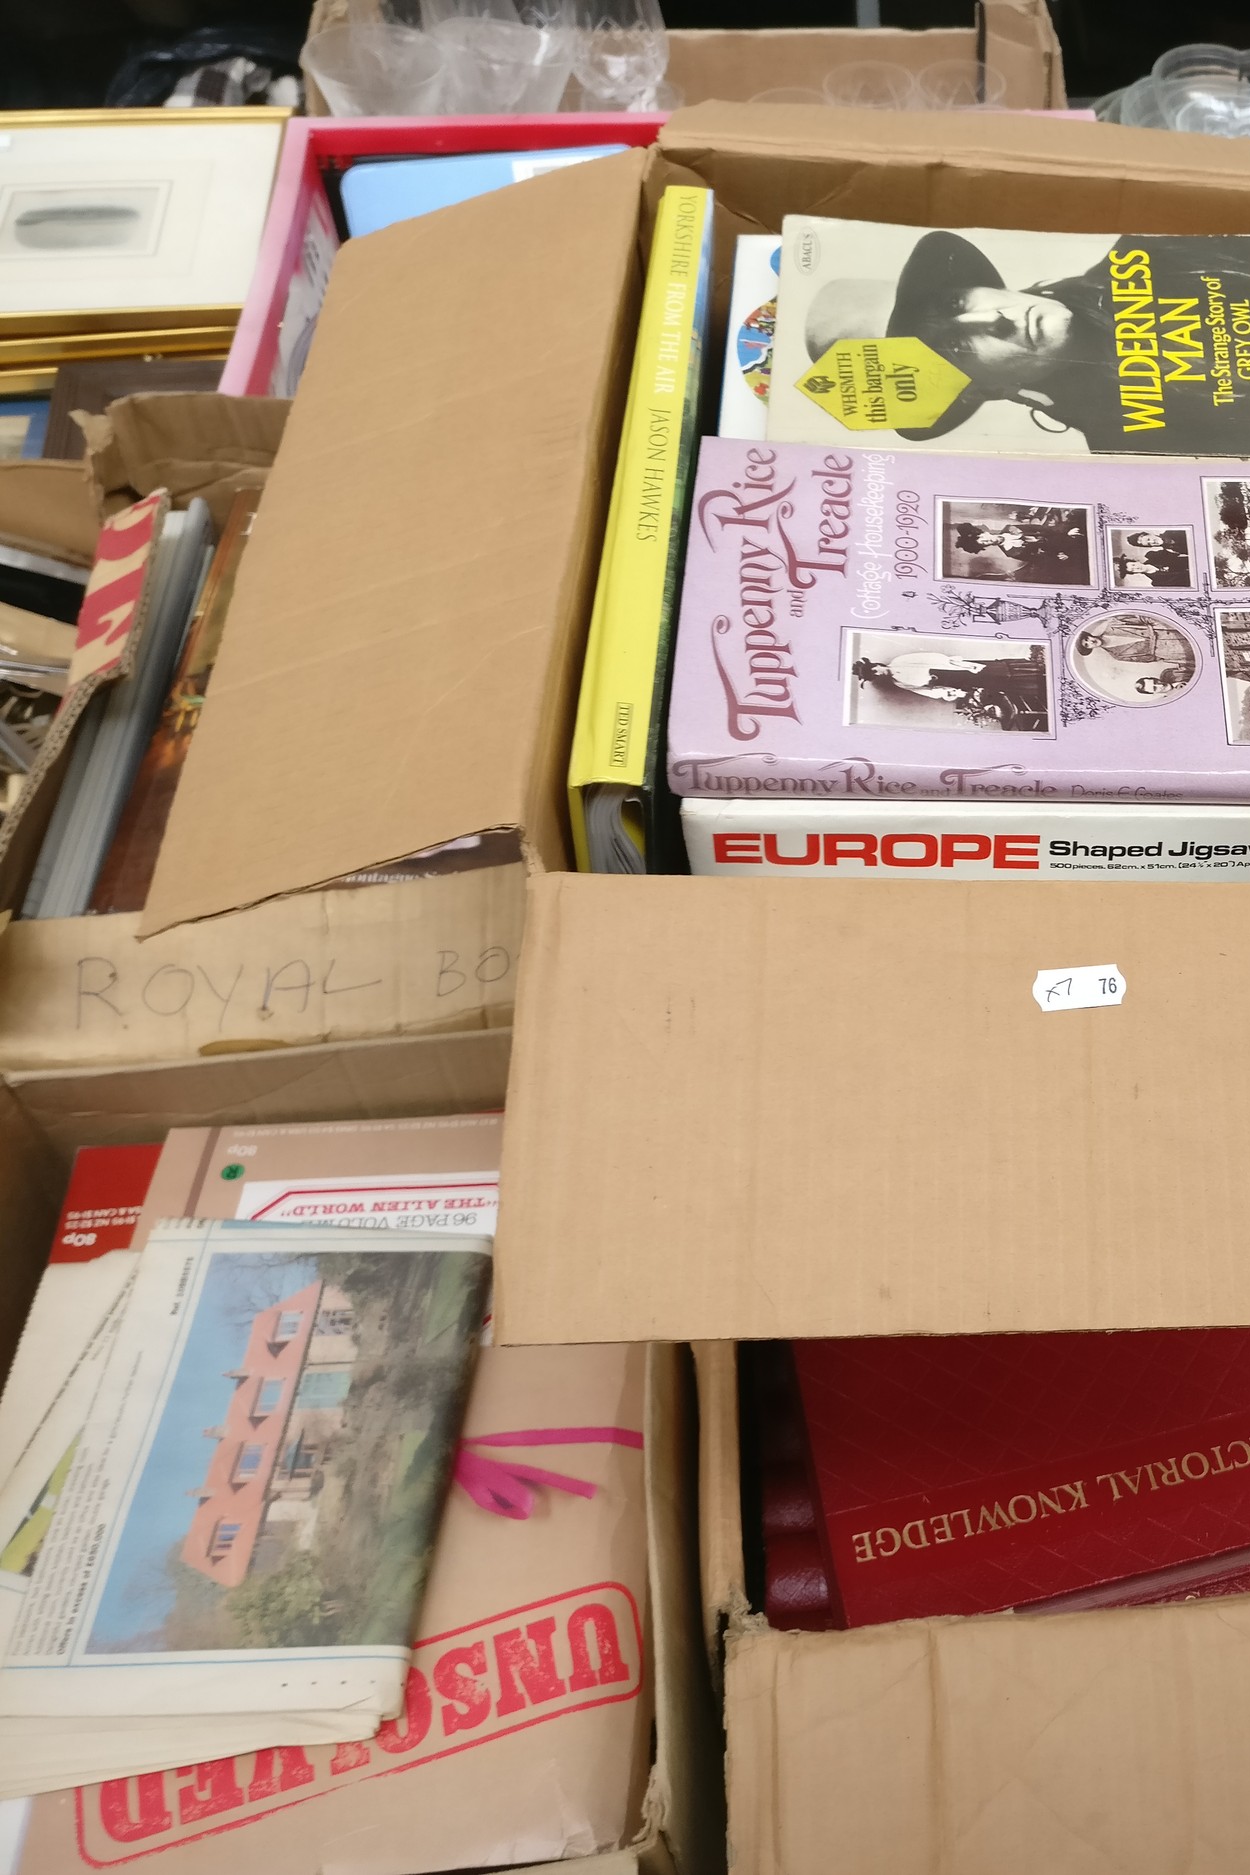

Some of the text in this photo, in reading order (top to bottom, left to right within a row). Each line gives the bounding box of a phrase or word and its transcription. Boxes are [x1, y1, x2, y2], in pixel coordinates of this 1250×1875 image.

[802, 233, 814, 270] ABACUS
[653, 195, 698, 395] YORKSHIRE FROM THE AIR
[1109, 249, 1166, 433] WILDERNESS
[1158, 297, 1207, 382] MAN
[1200, 276, 1234, 406] The Strange Story of
[836, 352, 858, 417] WHSMITH
[858, 344, 888, 424] this bargain
[886, 363, 920, 402] only
[636, 408, 672, 542] JASON HAWKES
[777, 453, 854, 618] and Treacle
[850, 453, 896, 619] Cottage Housekeeping
[894, 490, 928, 579] 1900-1920
[699, 448, 804, 741] Tuppenny Rice
[613, 704, 630, 766] TED SMART
[672, 752, 838, 797] Tuppenny
[819, 756, 917, 796] Rice
[940, 763, 1058, 798] Treacle
[712, 833, 1041, 869] EUROPE
[1049, 840, 1163, 861] Shaped
[75, 945, 520, 1031] ROYAL BO
[1098, 977, 1117, 994] 76
[371, 1198, 441, 1212] ALIEN
[398, 1212, 448, 1227] PAGE
[453, 1211, 477, 1226] 96
[852, 1481, 1090, 1563] KNOWLEDGE
